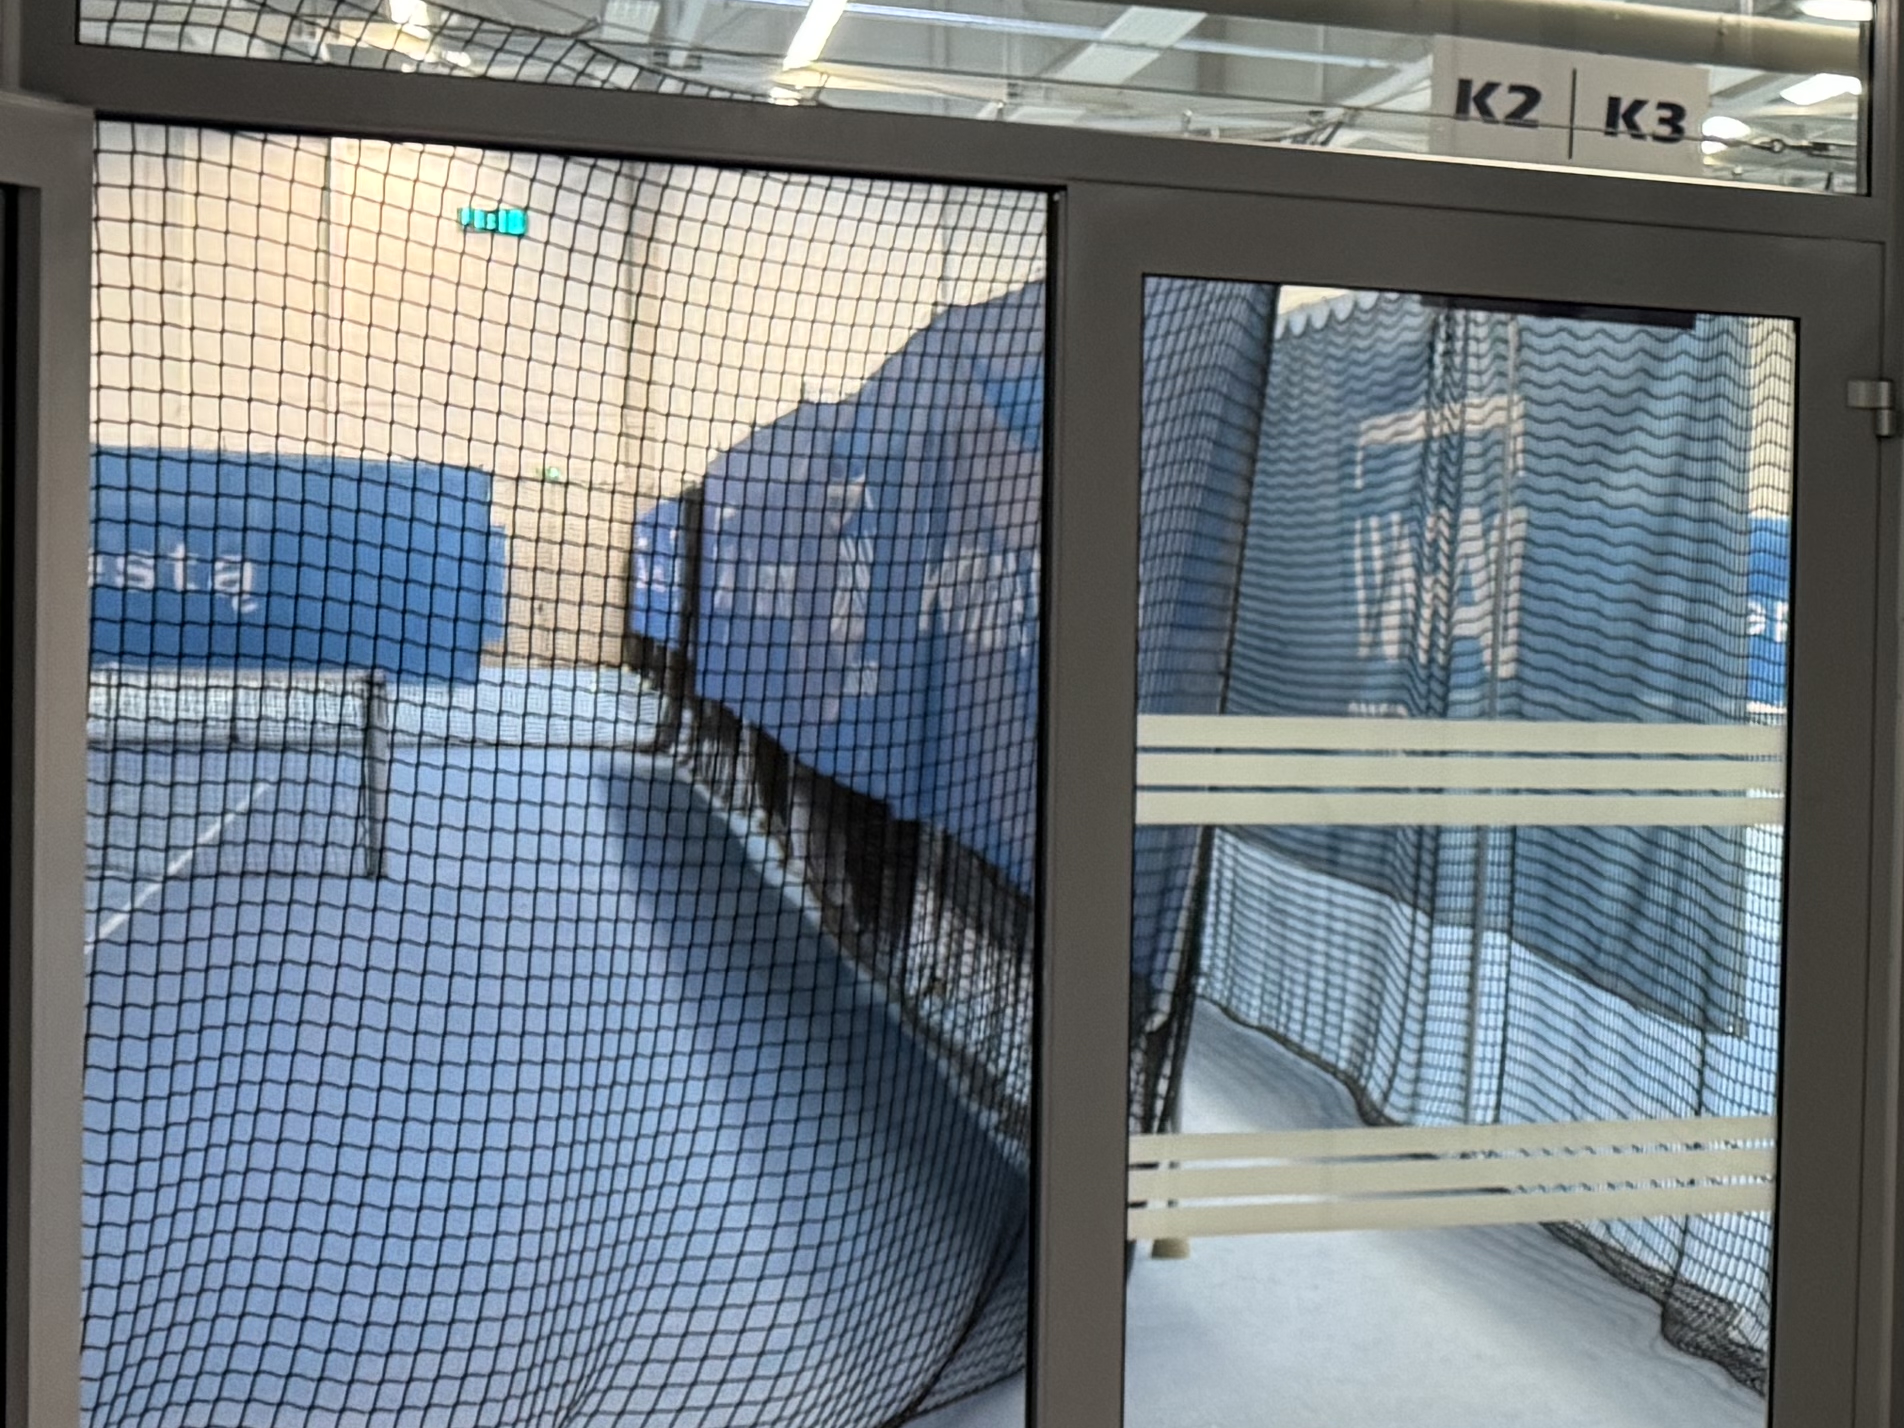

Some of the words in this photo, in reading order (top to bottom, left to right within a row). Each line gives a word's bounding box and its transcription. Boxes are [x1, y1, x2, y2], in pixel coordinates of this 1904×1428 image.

[1455, 77, 1542, 129] K2
[1604, 95, 1687, 144] K3
[88, 542, 257, 614] stą
